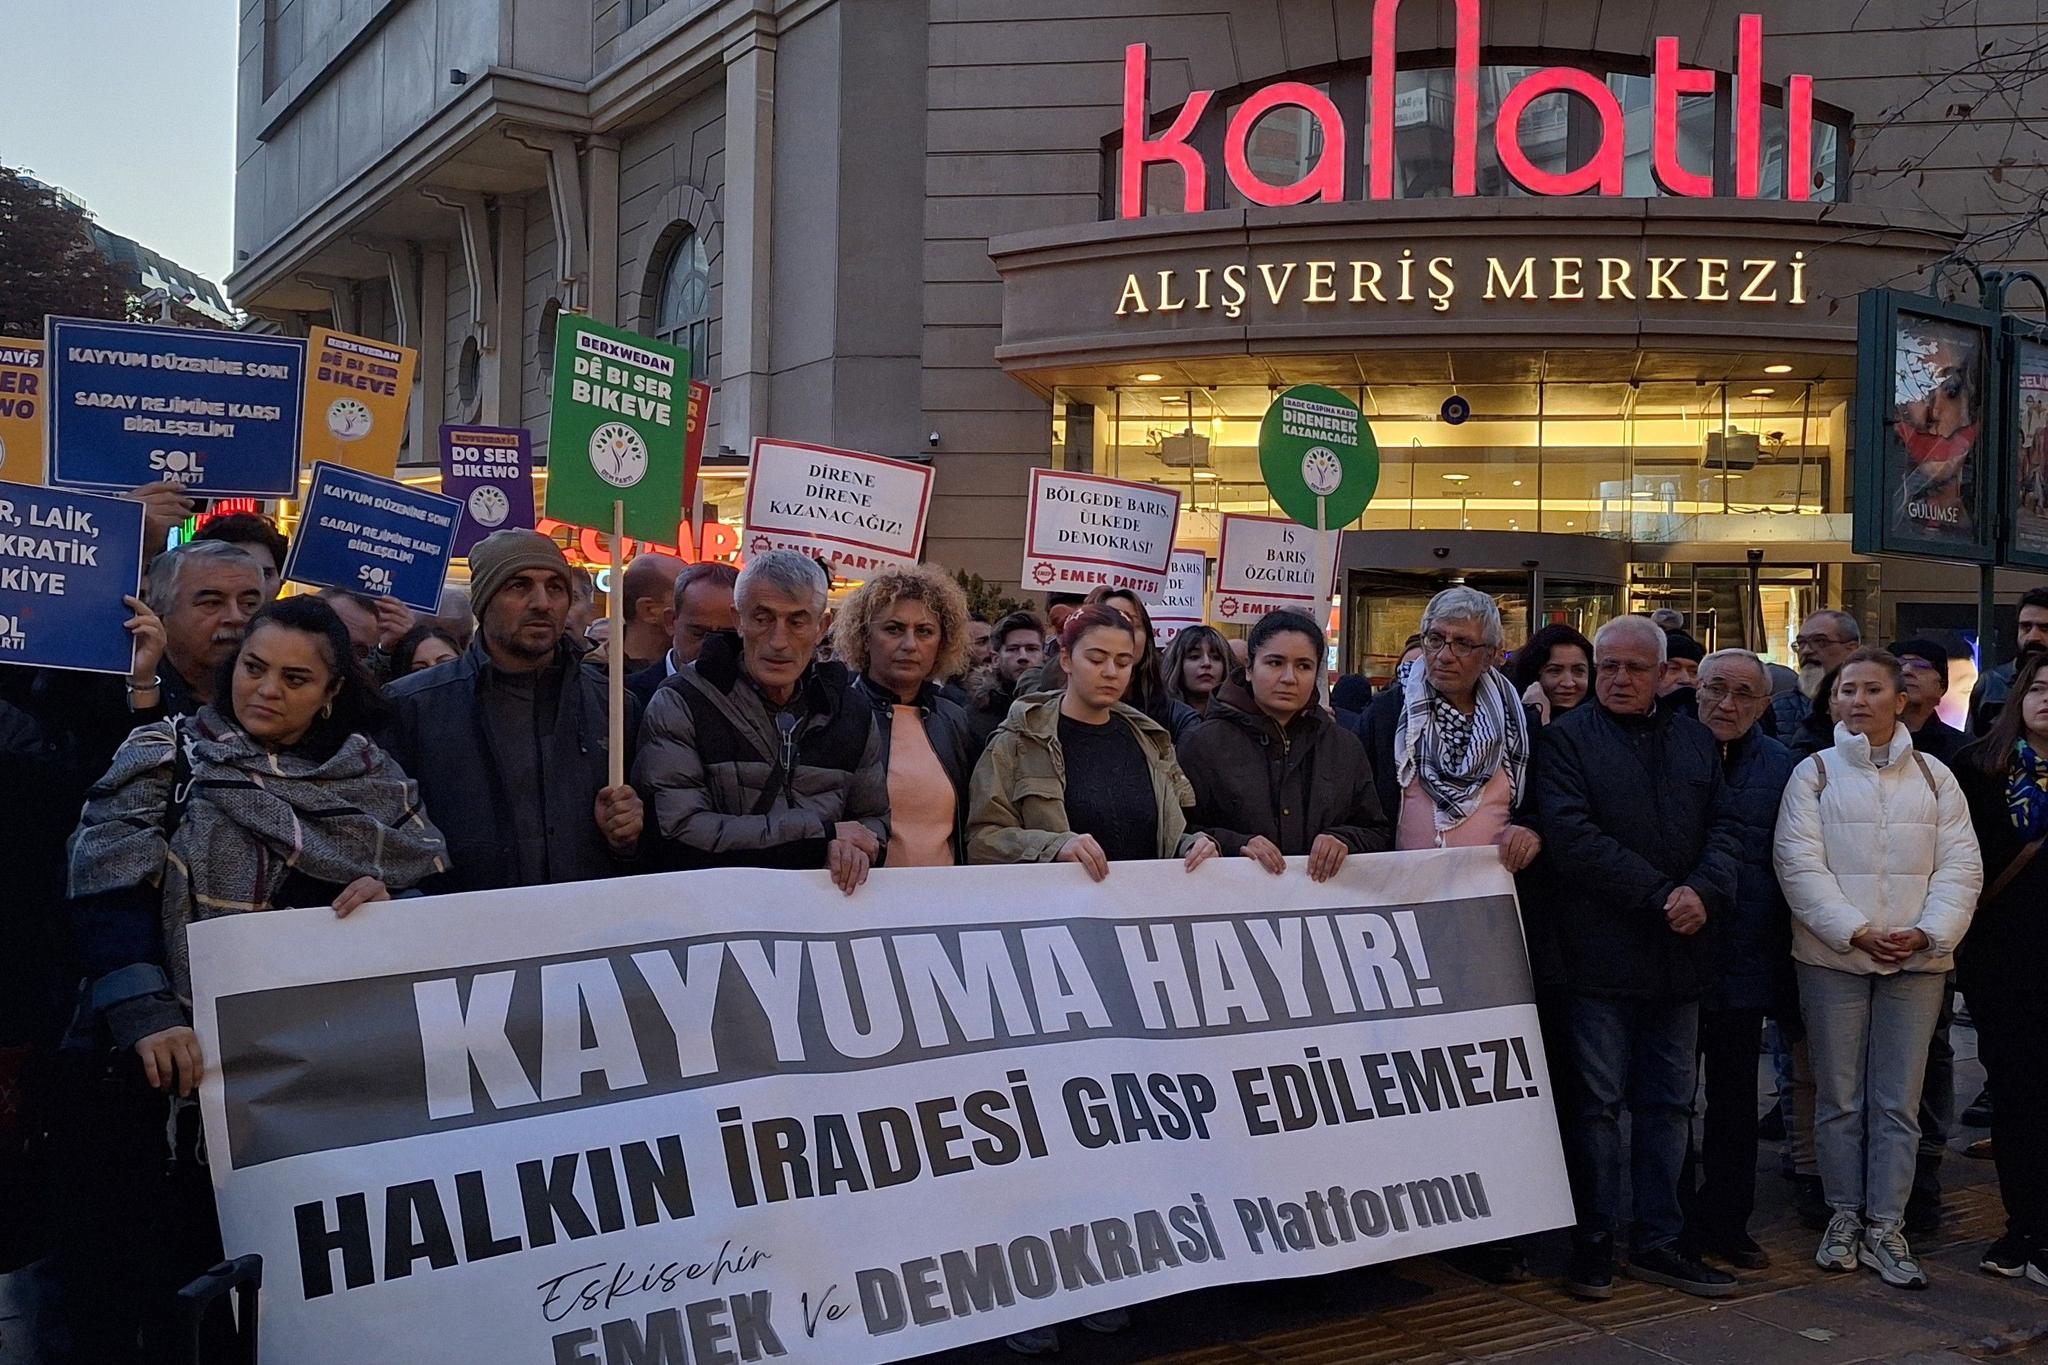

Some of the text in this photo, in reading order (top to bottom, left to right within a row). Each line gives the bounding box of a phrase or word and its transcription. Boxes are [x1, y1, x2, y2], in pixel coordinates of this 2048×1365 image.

[1115, 249, 1807, 318] ALIŞVERİŞ MERKEZİ
[69, 347, 289, 379] KAYYUM DÜZENİNE SON!
[582, 336, 670, 372] BERXWEDAN
[317, 366, 397, 397] BIKEVE
[575, 357, 602, 380] DÊ
[606, 366, 629, 388] BI
[633, 375, 672, 400] SER
[75, 391, 281, 421] SARAY REJİMİNE KARŞI
[572, 379, 671, 427] BIKEVE
[124, 415, 235, 438] BİRLEŞELİM!
[1282, 424, 1358, 446] KAZANACAĞIZ
[1283, 410, 1358, 434] DİRENEREK
[149, 449, 205, 472] SOL
[452, 446, 519, 463] DO SER
[452, 463, 520, 479] BIKEWO
[808, 464, 876, 488] DİRENE
[323, 484, 373, 506] KAYYUM
[374, 498, 427, 521] DÜZENİNE
[805, 484, 873, 508] DİRENE
[1046, 486, 1122, 509] BÖLGEDE
[30, 505, 99, 538] LAİK,
[769, 500, 903, 535] KAZANACAĞIZ!
[1080, 509, 1141, 532] ÜLKEDE
[320, 516, 361, 534] SARAY
[362, 527, 412, 548] REJİMİNE
[1282, 527, 1295, 544] İŞ
[1267, 549, 1306, 565] BARIŞ
[358, 565, 392, 586] SOL
[1060, 569, 1159, 593] EMEK PARTİSİ
[413, 910, 1444, 1121] KAYYUMA HAYIR!
[295, 1036, 1540, 1300] HALKIN İRADESİ GASP EDİLEMEZ!
[551, 1170, 1493, 1365] EMEK Ve DEMOKRASİ Platformu
